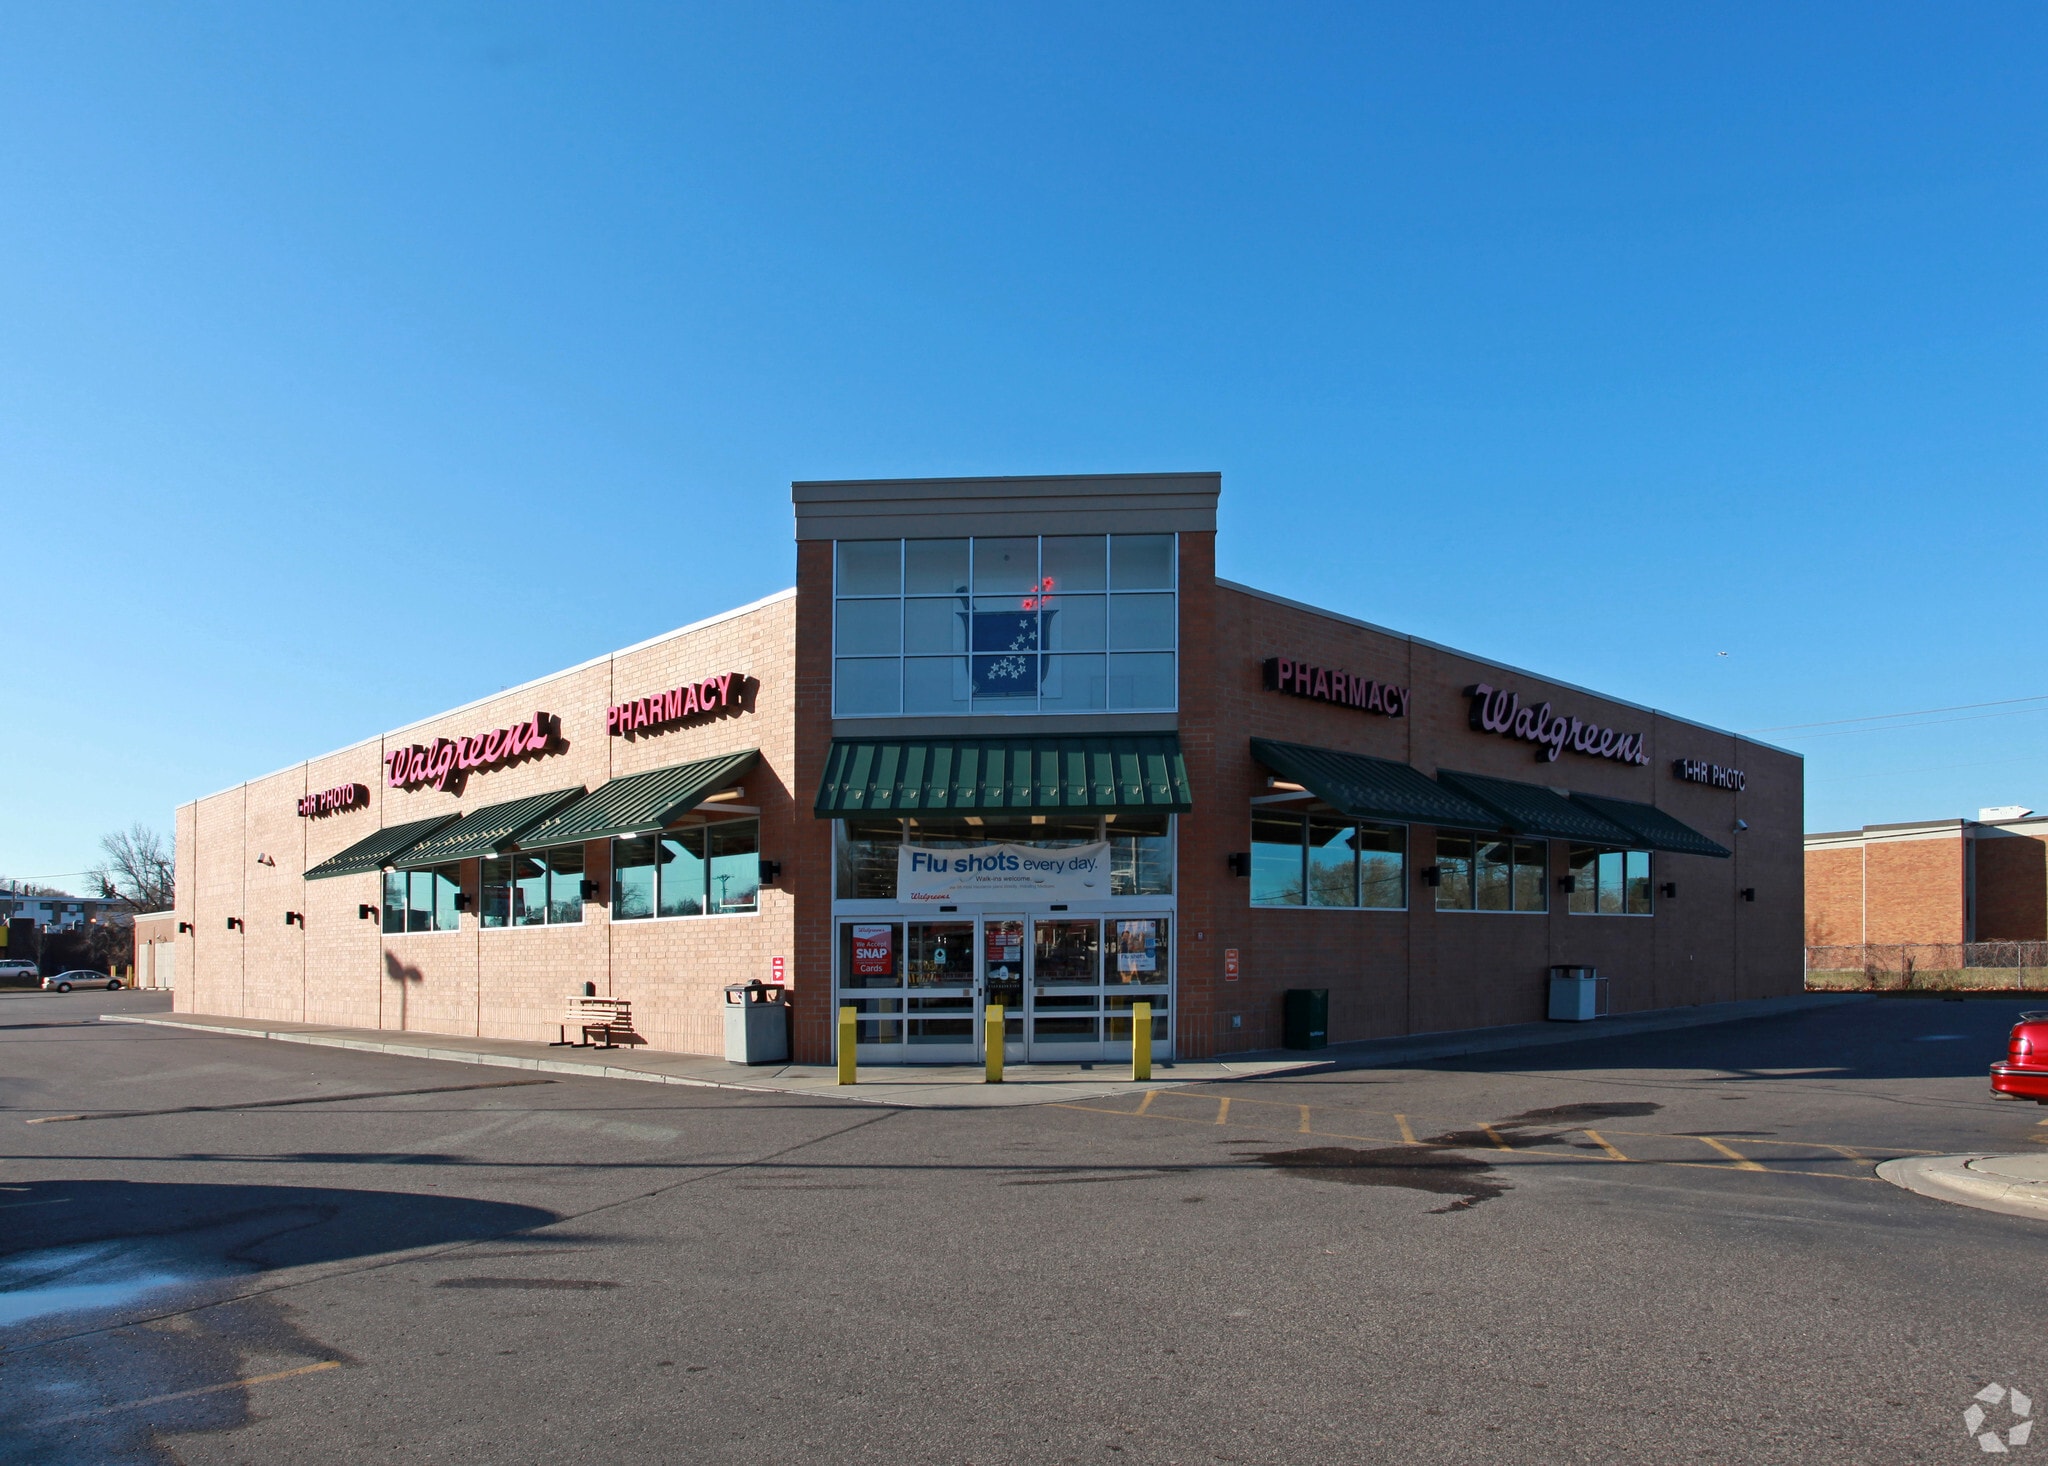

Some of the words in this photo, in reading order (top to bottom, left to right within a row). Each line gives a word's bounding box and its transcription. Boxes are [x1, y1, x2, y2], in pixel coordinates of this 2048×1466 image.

[1278, 656, 1410, 717] PHARMACY
[606, 672, 733, 736] PHARMACY
[1475, 682, 1650, 766] Walgreens
[384, 711, 548, 793] Walgreens
[1683, 758, 1708, 783] 1-HR
[321, 783, 354, 811] PHOTO
[911, 852, 948, 873] Flu
[954, 851, 1020, 872] shots
[1023, 859, 1065, 875] every
[1068, 857, 1099, 873] day.
[911, 892, 951, 902] Walgreens
[856, 948, 888, 959] SNAP
[860, 964, 883, 973] Cards
